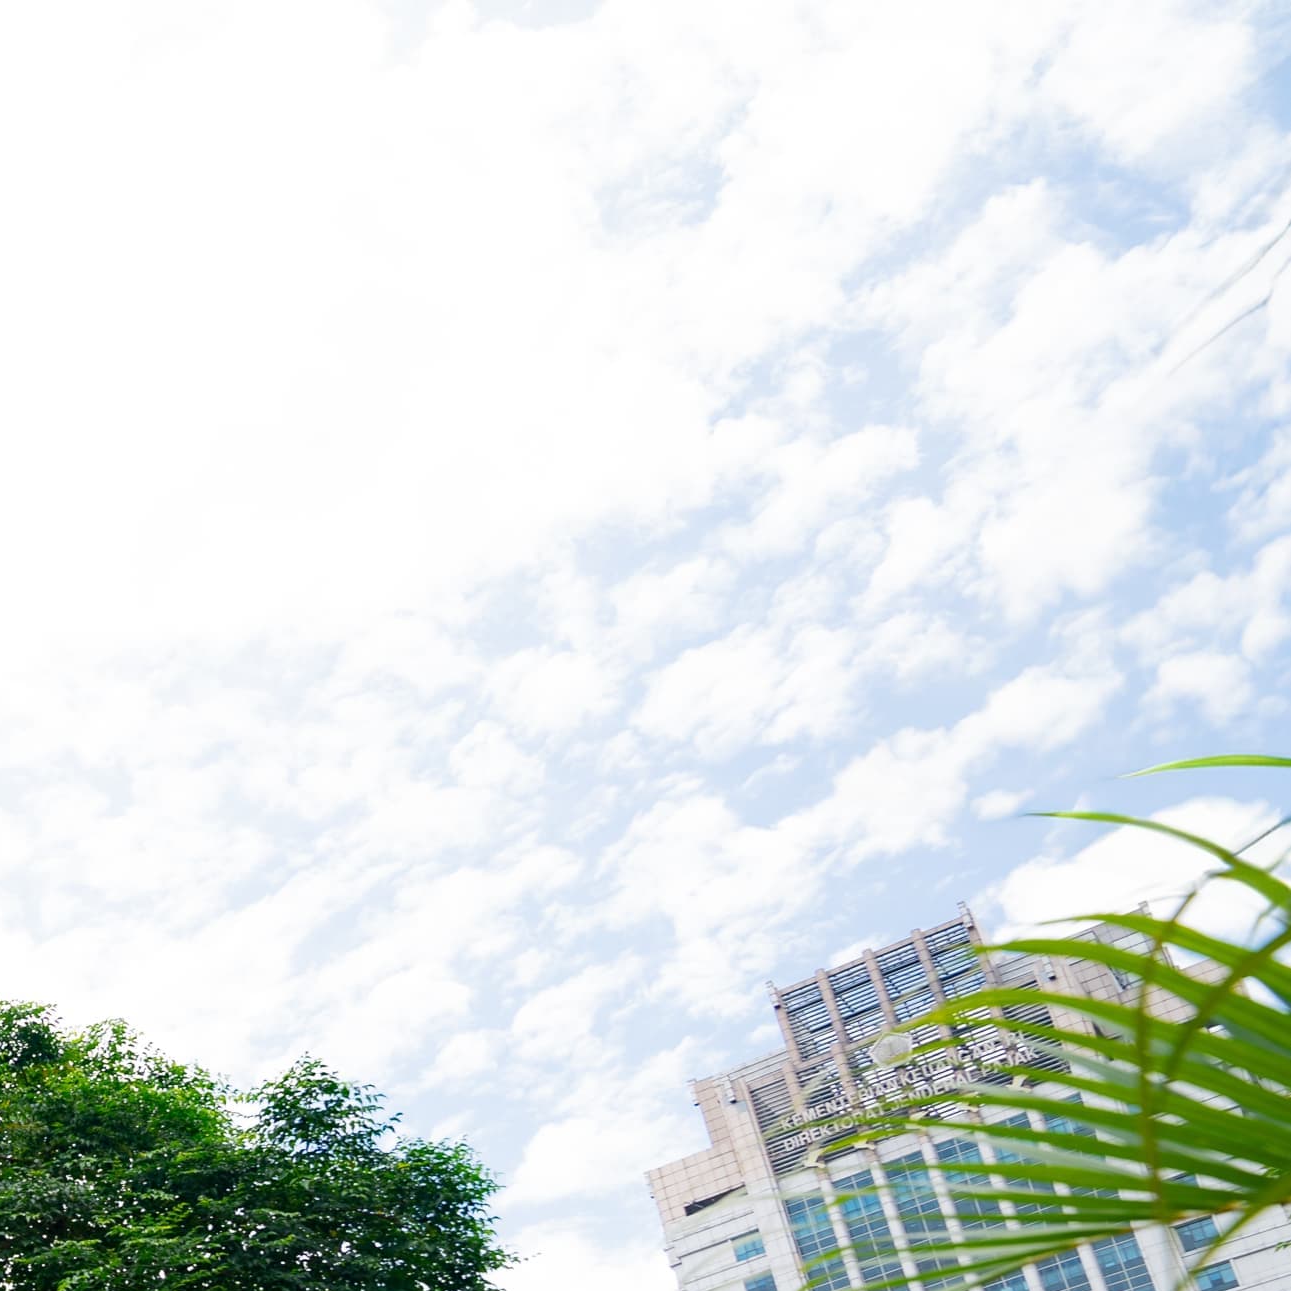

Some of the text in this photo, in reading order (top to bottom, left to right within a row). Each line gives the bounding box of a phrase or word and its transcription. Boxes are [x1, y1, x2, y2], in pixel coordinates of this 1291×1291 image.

[781, 1078, 898, 1130] KEMENTERIAN
[901, 1040, 997, 1087] KEUANGAN
[784, 1105, 886, 1151] DIREKTORAT
